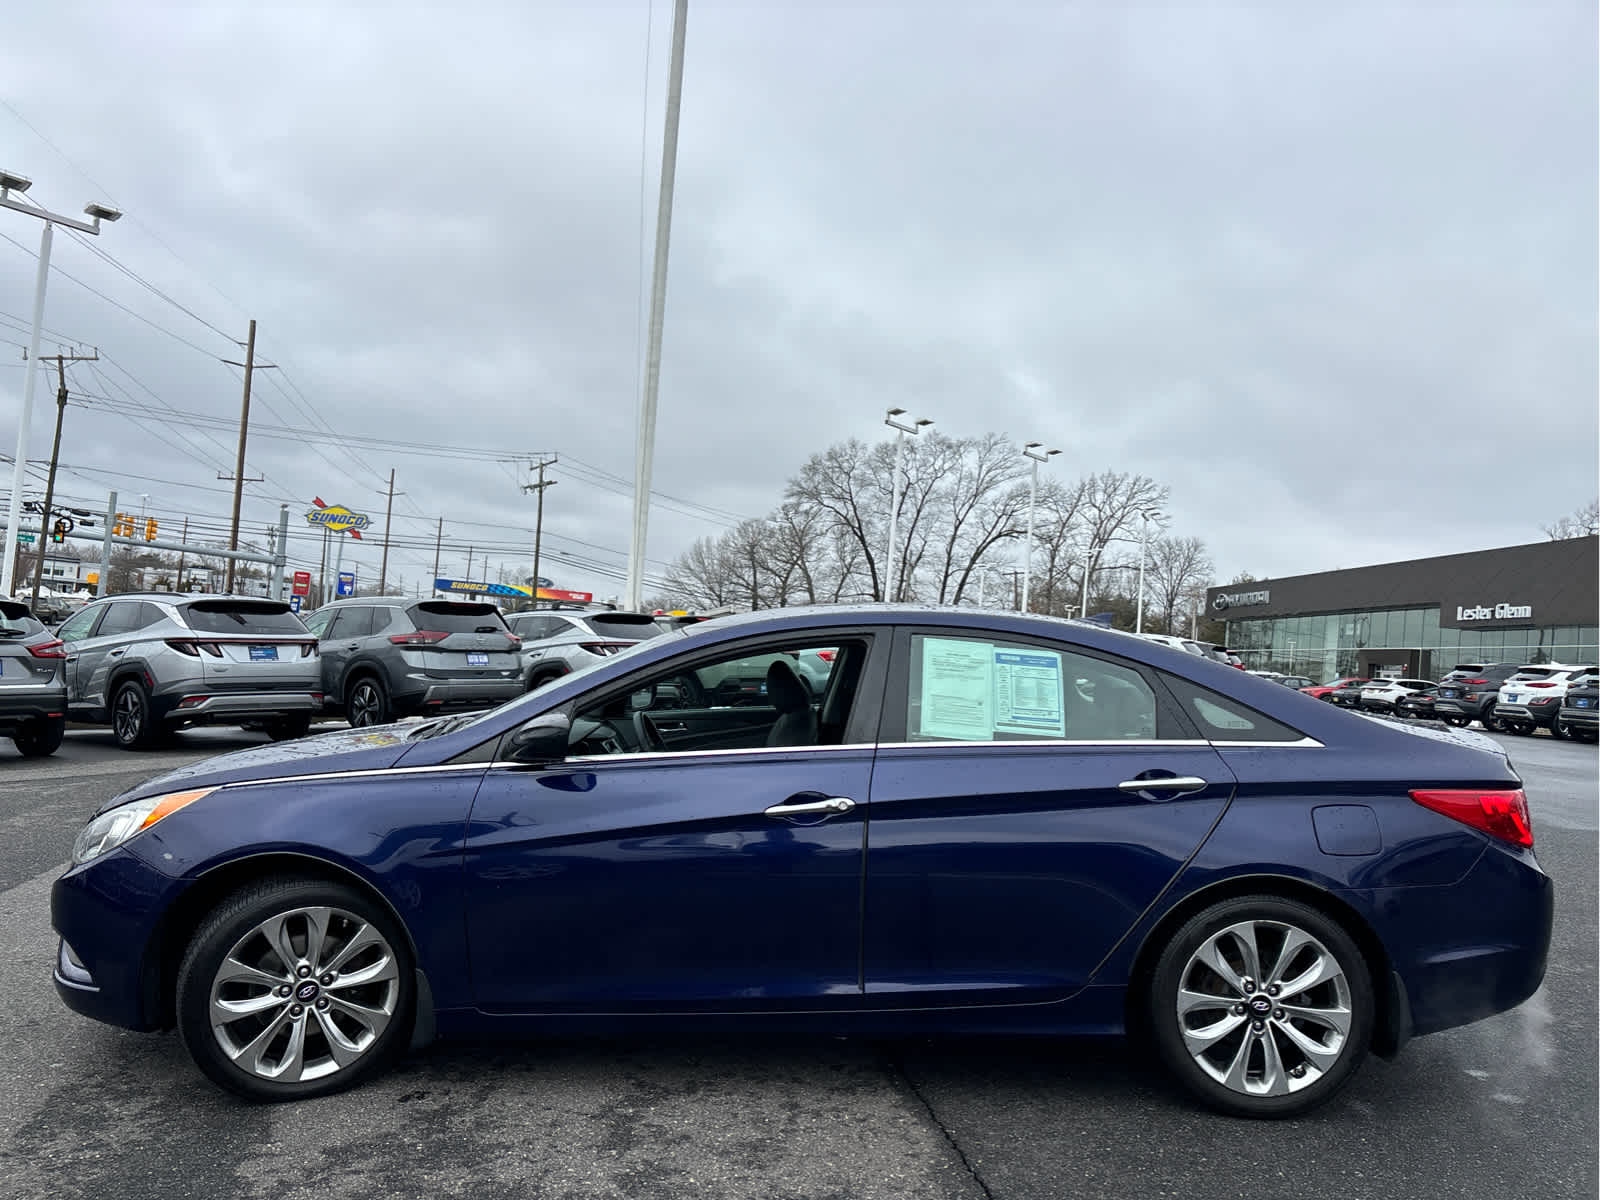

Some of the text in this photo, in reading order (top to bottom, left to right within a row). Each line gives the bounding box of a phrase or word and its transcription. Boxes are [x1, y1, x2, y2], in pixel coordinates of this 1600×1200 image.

[310, 512, 365, 526] SUNOCO
[450, 582, 489, 592] SUNOCO
[1456, 603, 1532, 621] Lester Glenn
